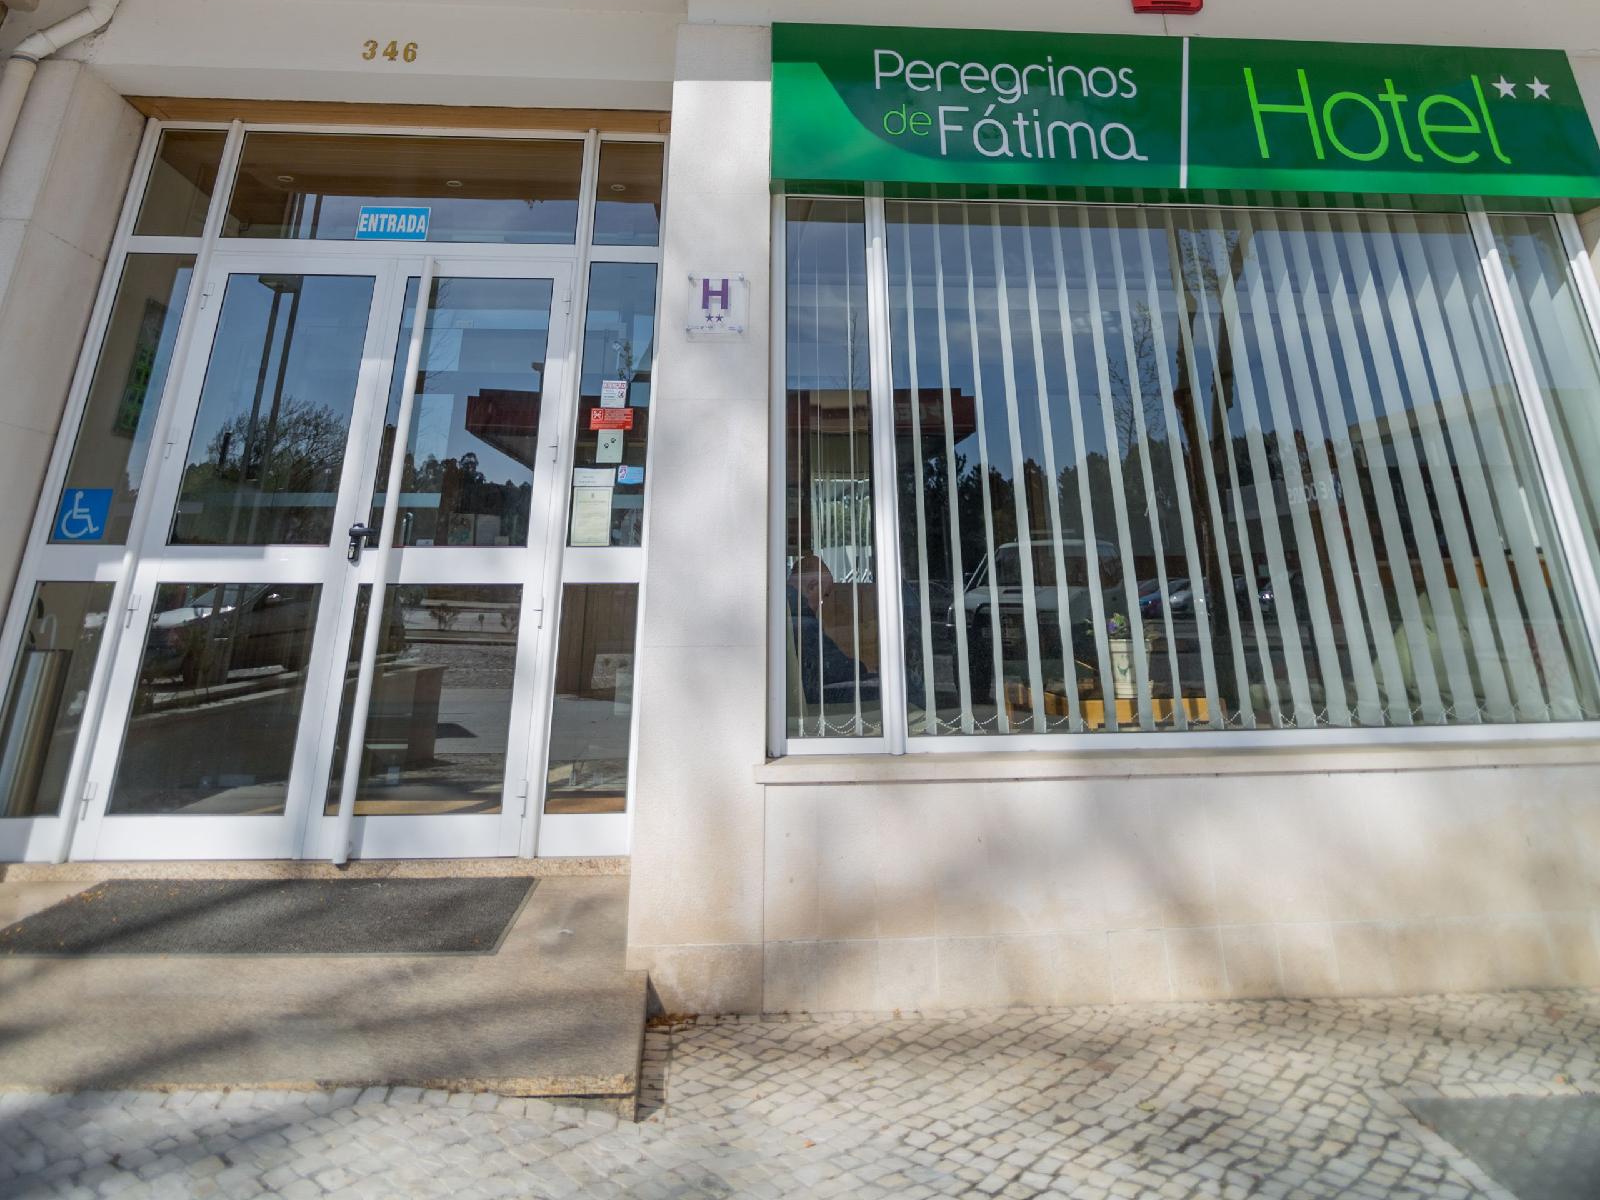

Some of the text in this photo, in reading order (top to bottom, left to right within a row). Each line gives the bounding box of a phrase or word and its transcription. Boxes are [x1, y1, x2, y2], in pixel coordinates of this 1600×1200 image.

[362, 40, 418, 63] 346
[874, 49, 1137, 104] Peregrinos
[883, 104, 1149, 161] de Fátima
[1243, 67, 1512, 164] Hotel
[358, 213, 426, 233] ENTRADA
[702, 278, 729, 310] H
